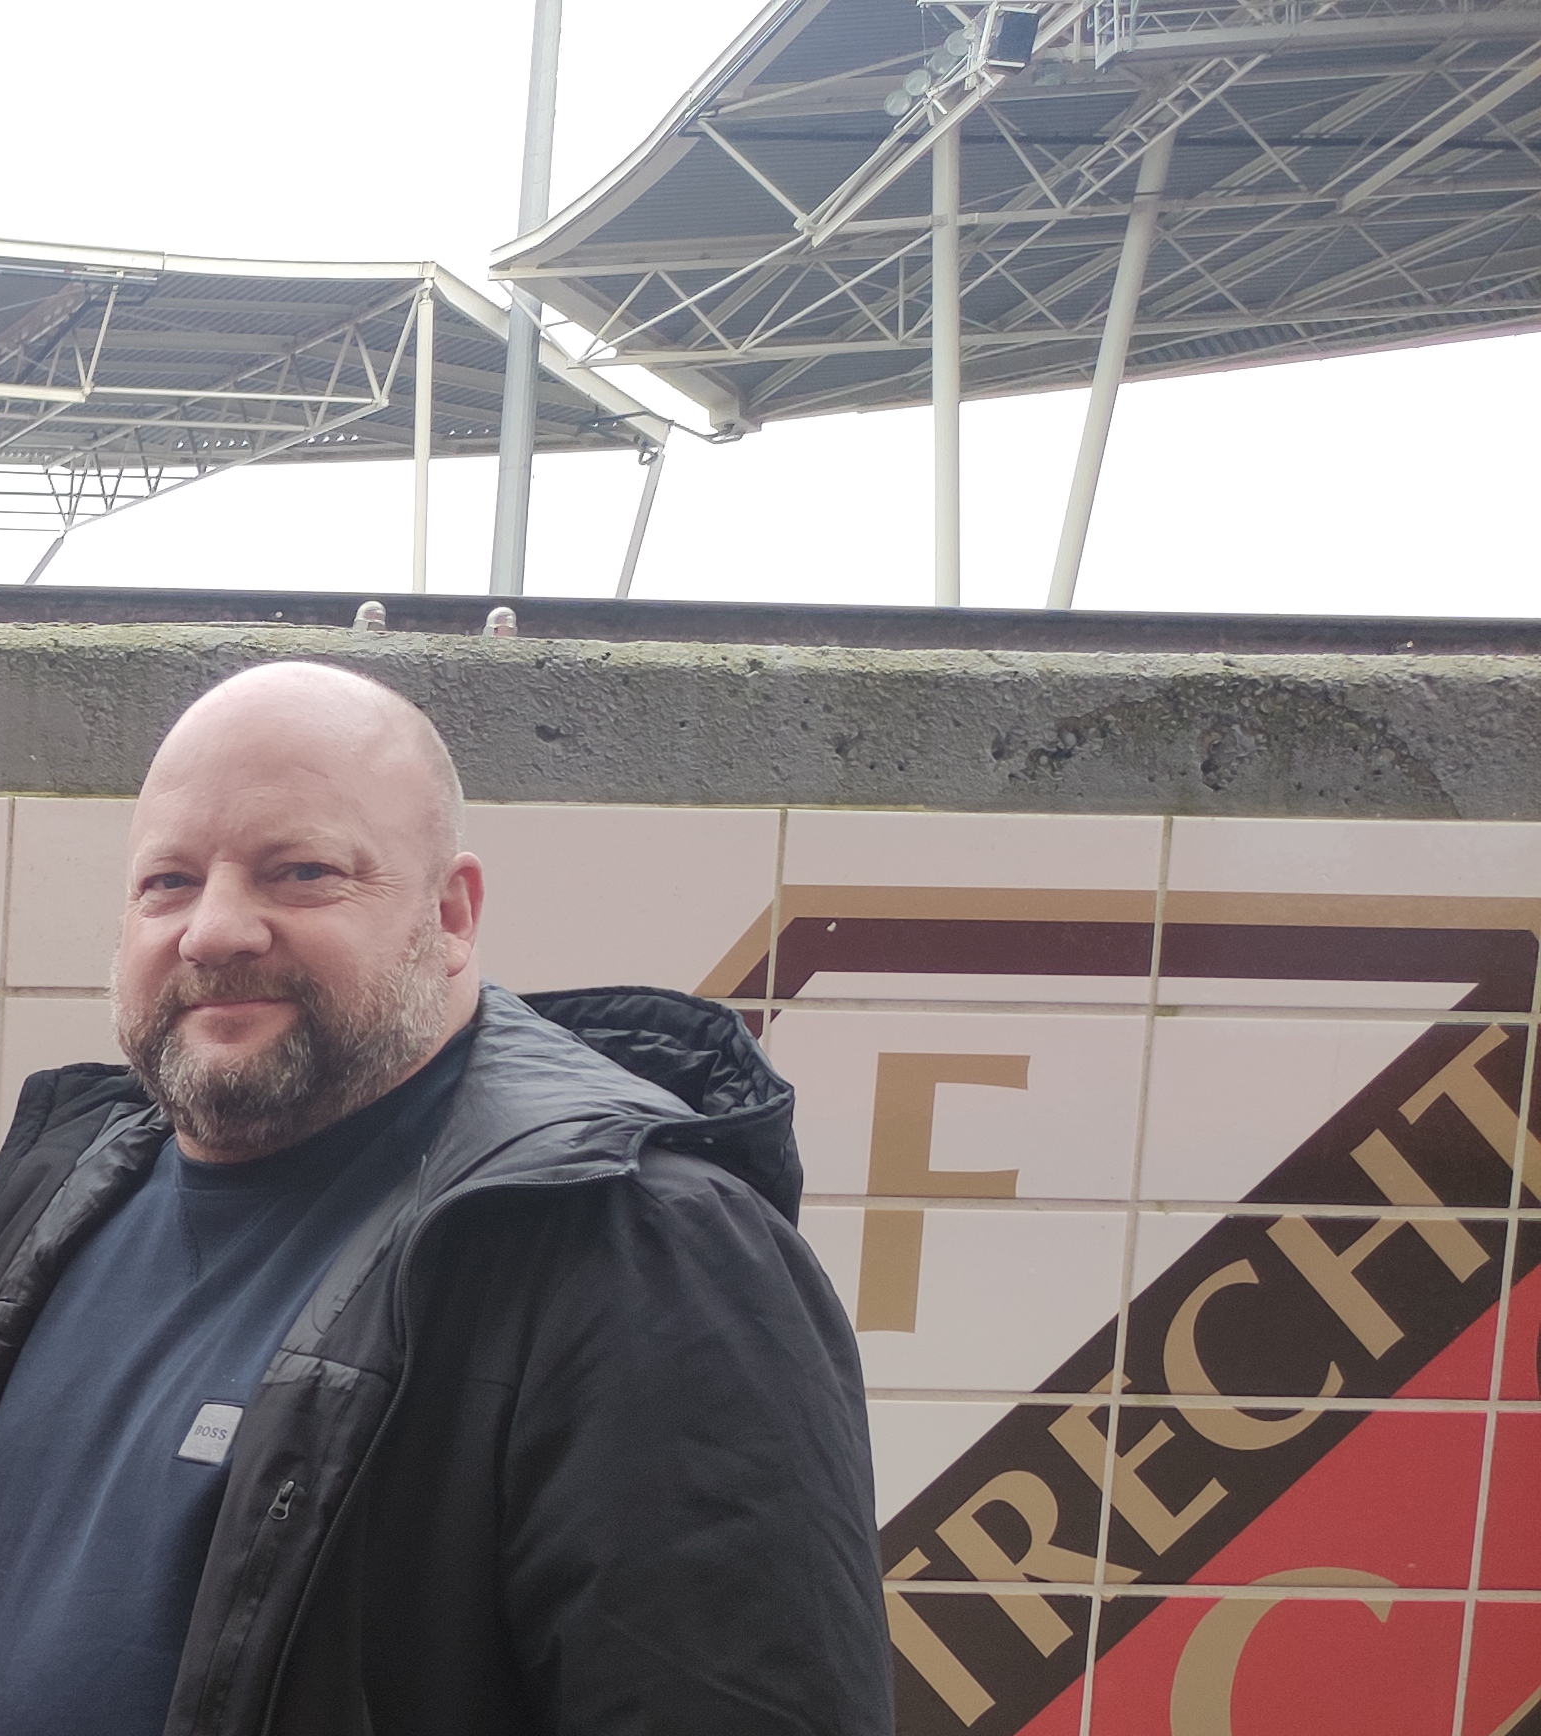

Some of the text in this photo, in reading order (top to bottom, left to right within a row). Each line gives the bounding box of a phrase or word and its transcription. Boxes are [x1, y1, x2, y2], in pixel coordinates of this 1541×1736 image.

[856, 1052, 1031, 1333] F
[193, 1424, 228, 1441] BOSS
[882, 1023, 1541, 1728] TRECHT
